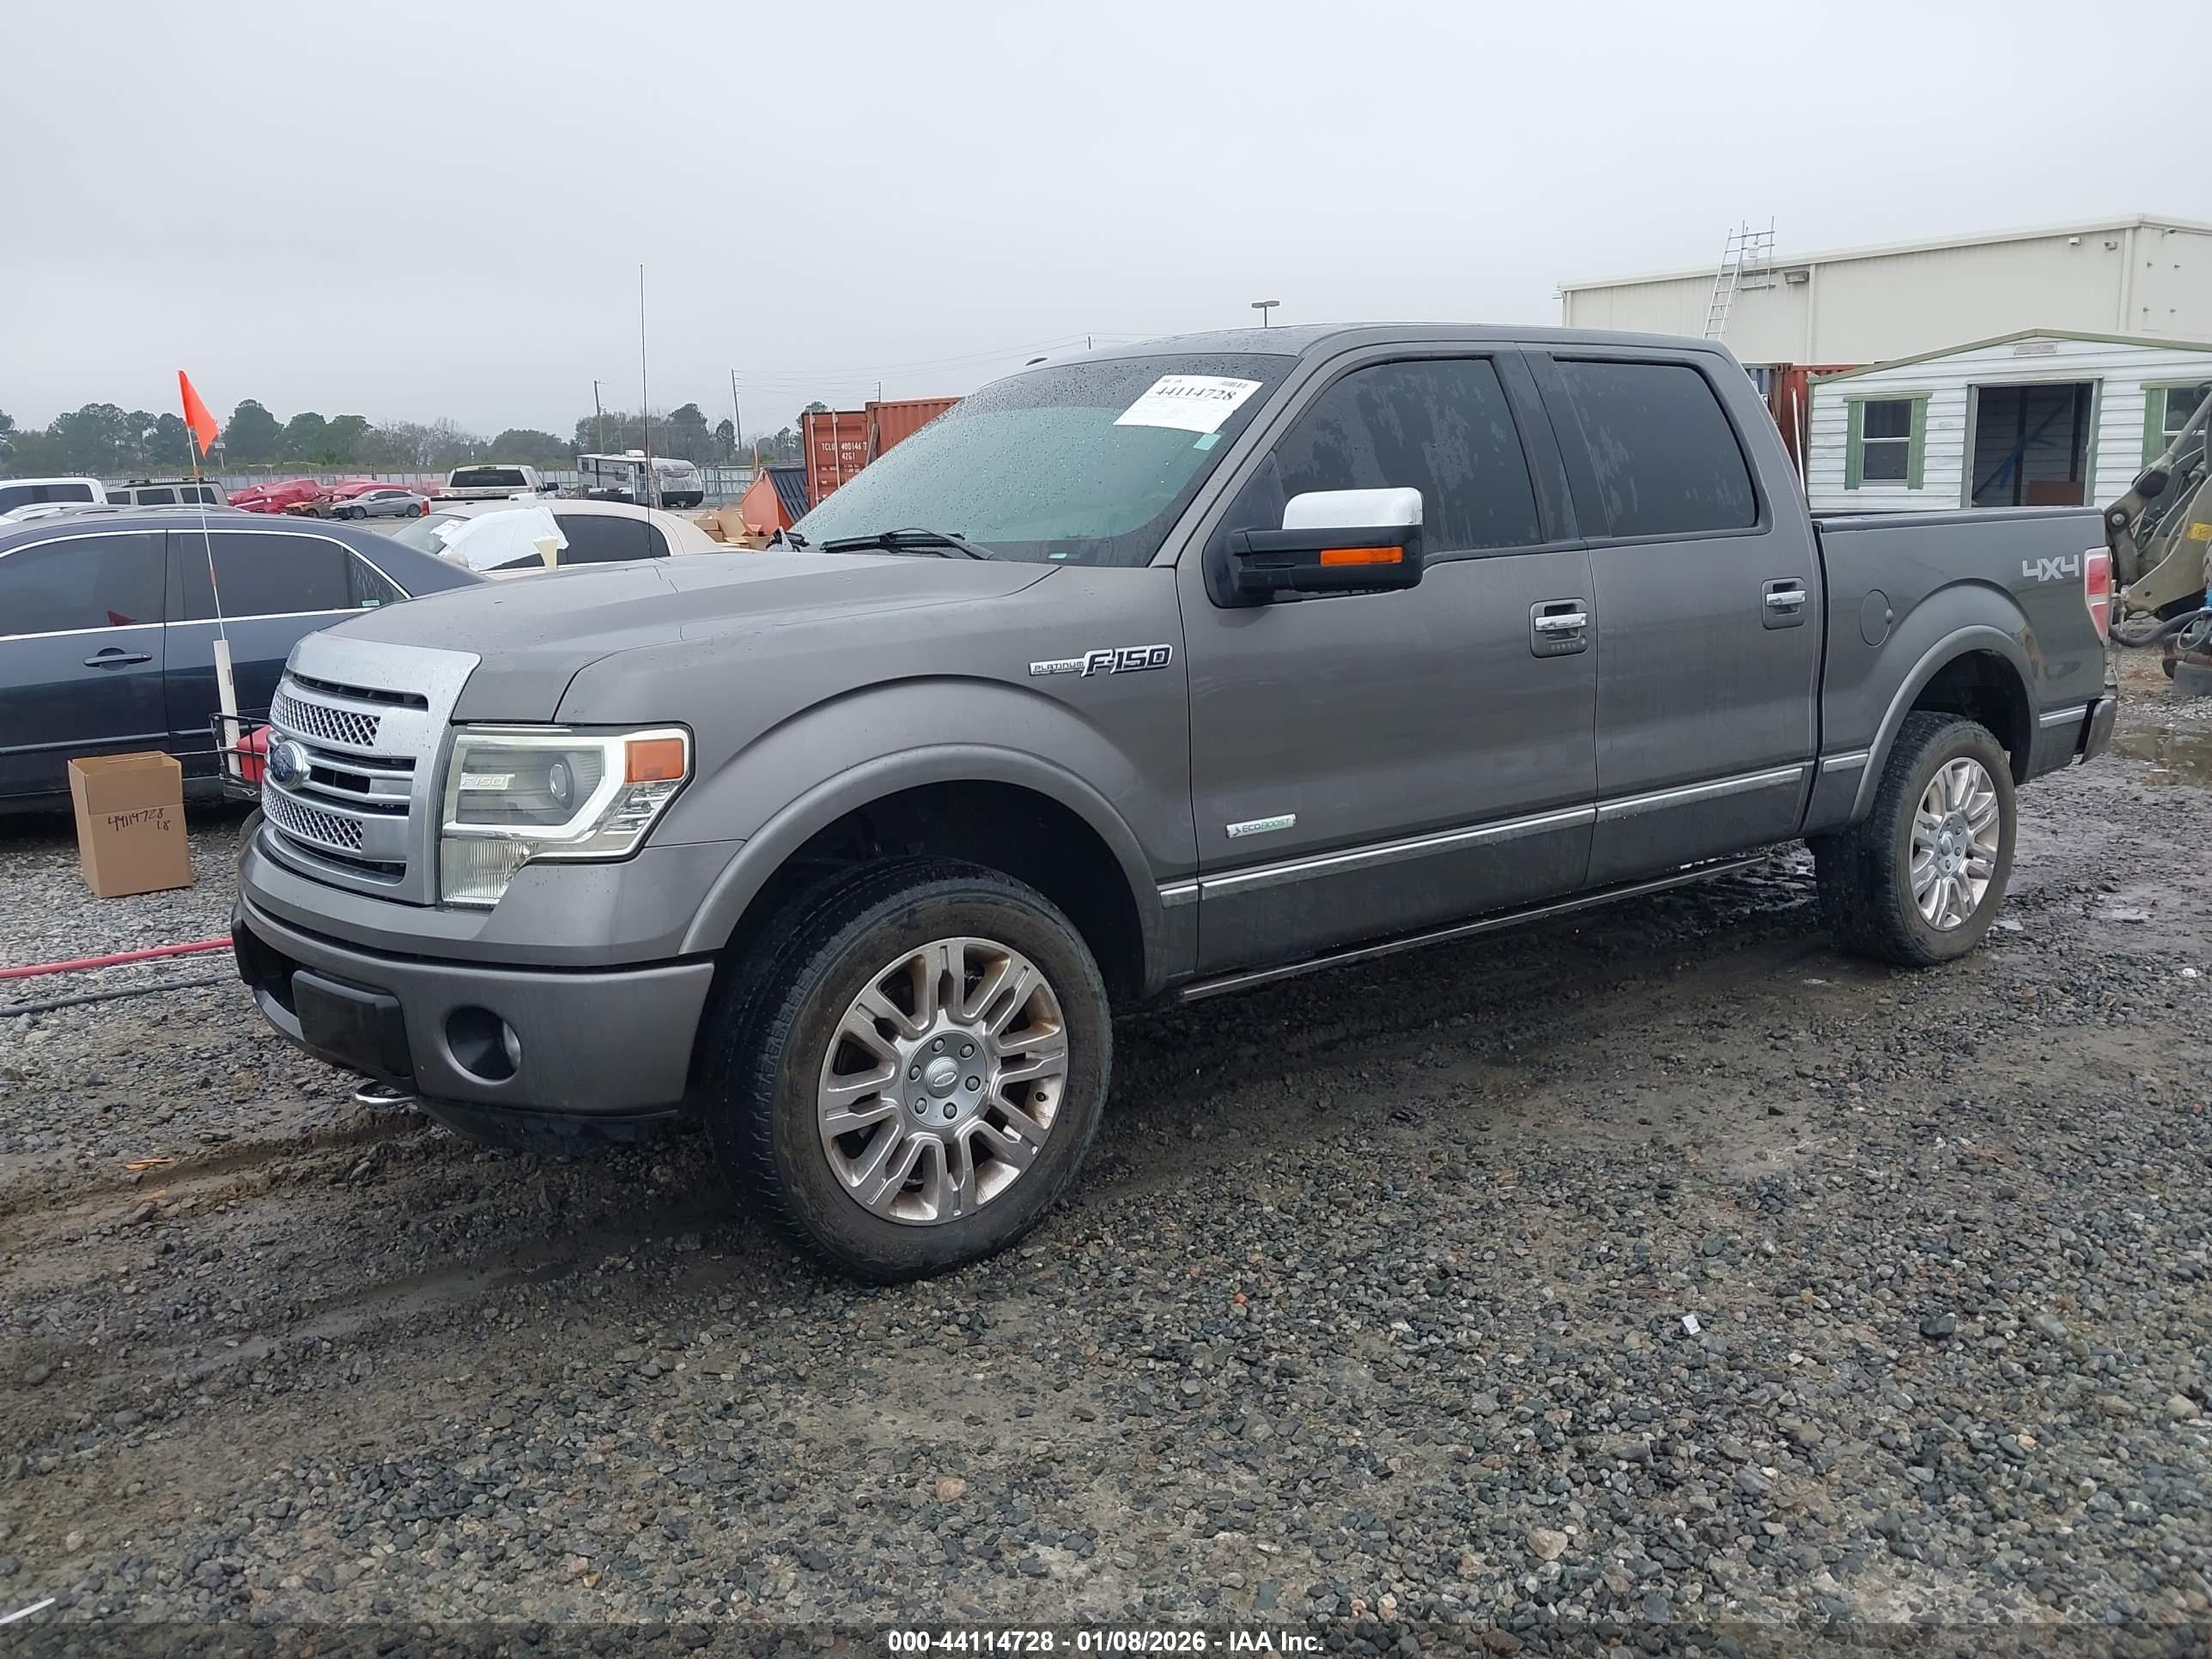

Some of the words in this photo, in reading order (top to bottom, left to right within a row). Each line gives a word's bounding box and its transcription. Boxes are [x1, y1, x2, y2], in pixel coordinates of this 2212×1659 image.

[1156, 386, 1237, 401] 44114728
[1033, 660, 1085, 672] PLATINUM
[1084, 645, 1172, 675] F-150
[1242, 818, 1291, 833] ECOBOOST
